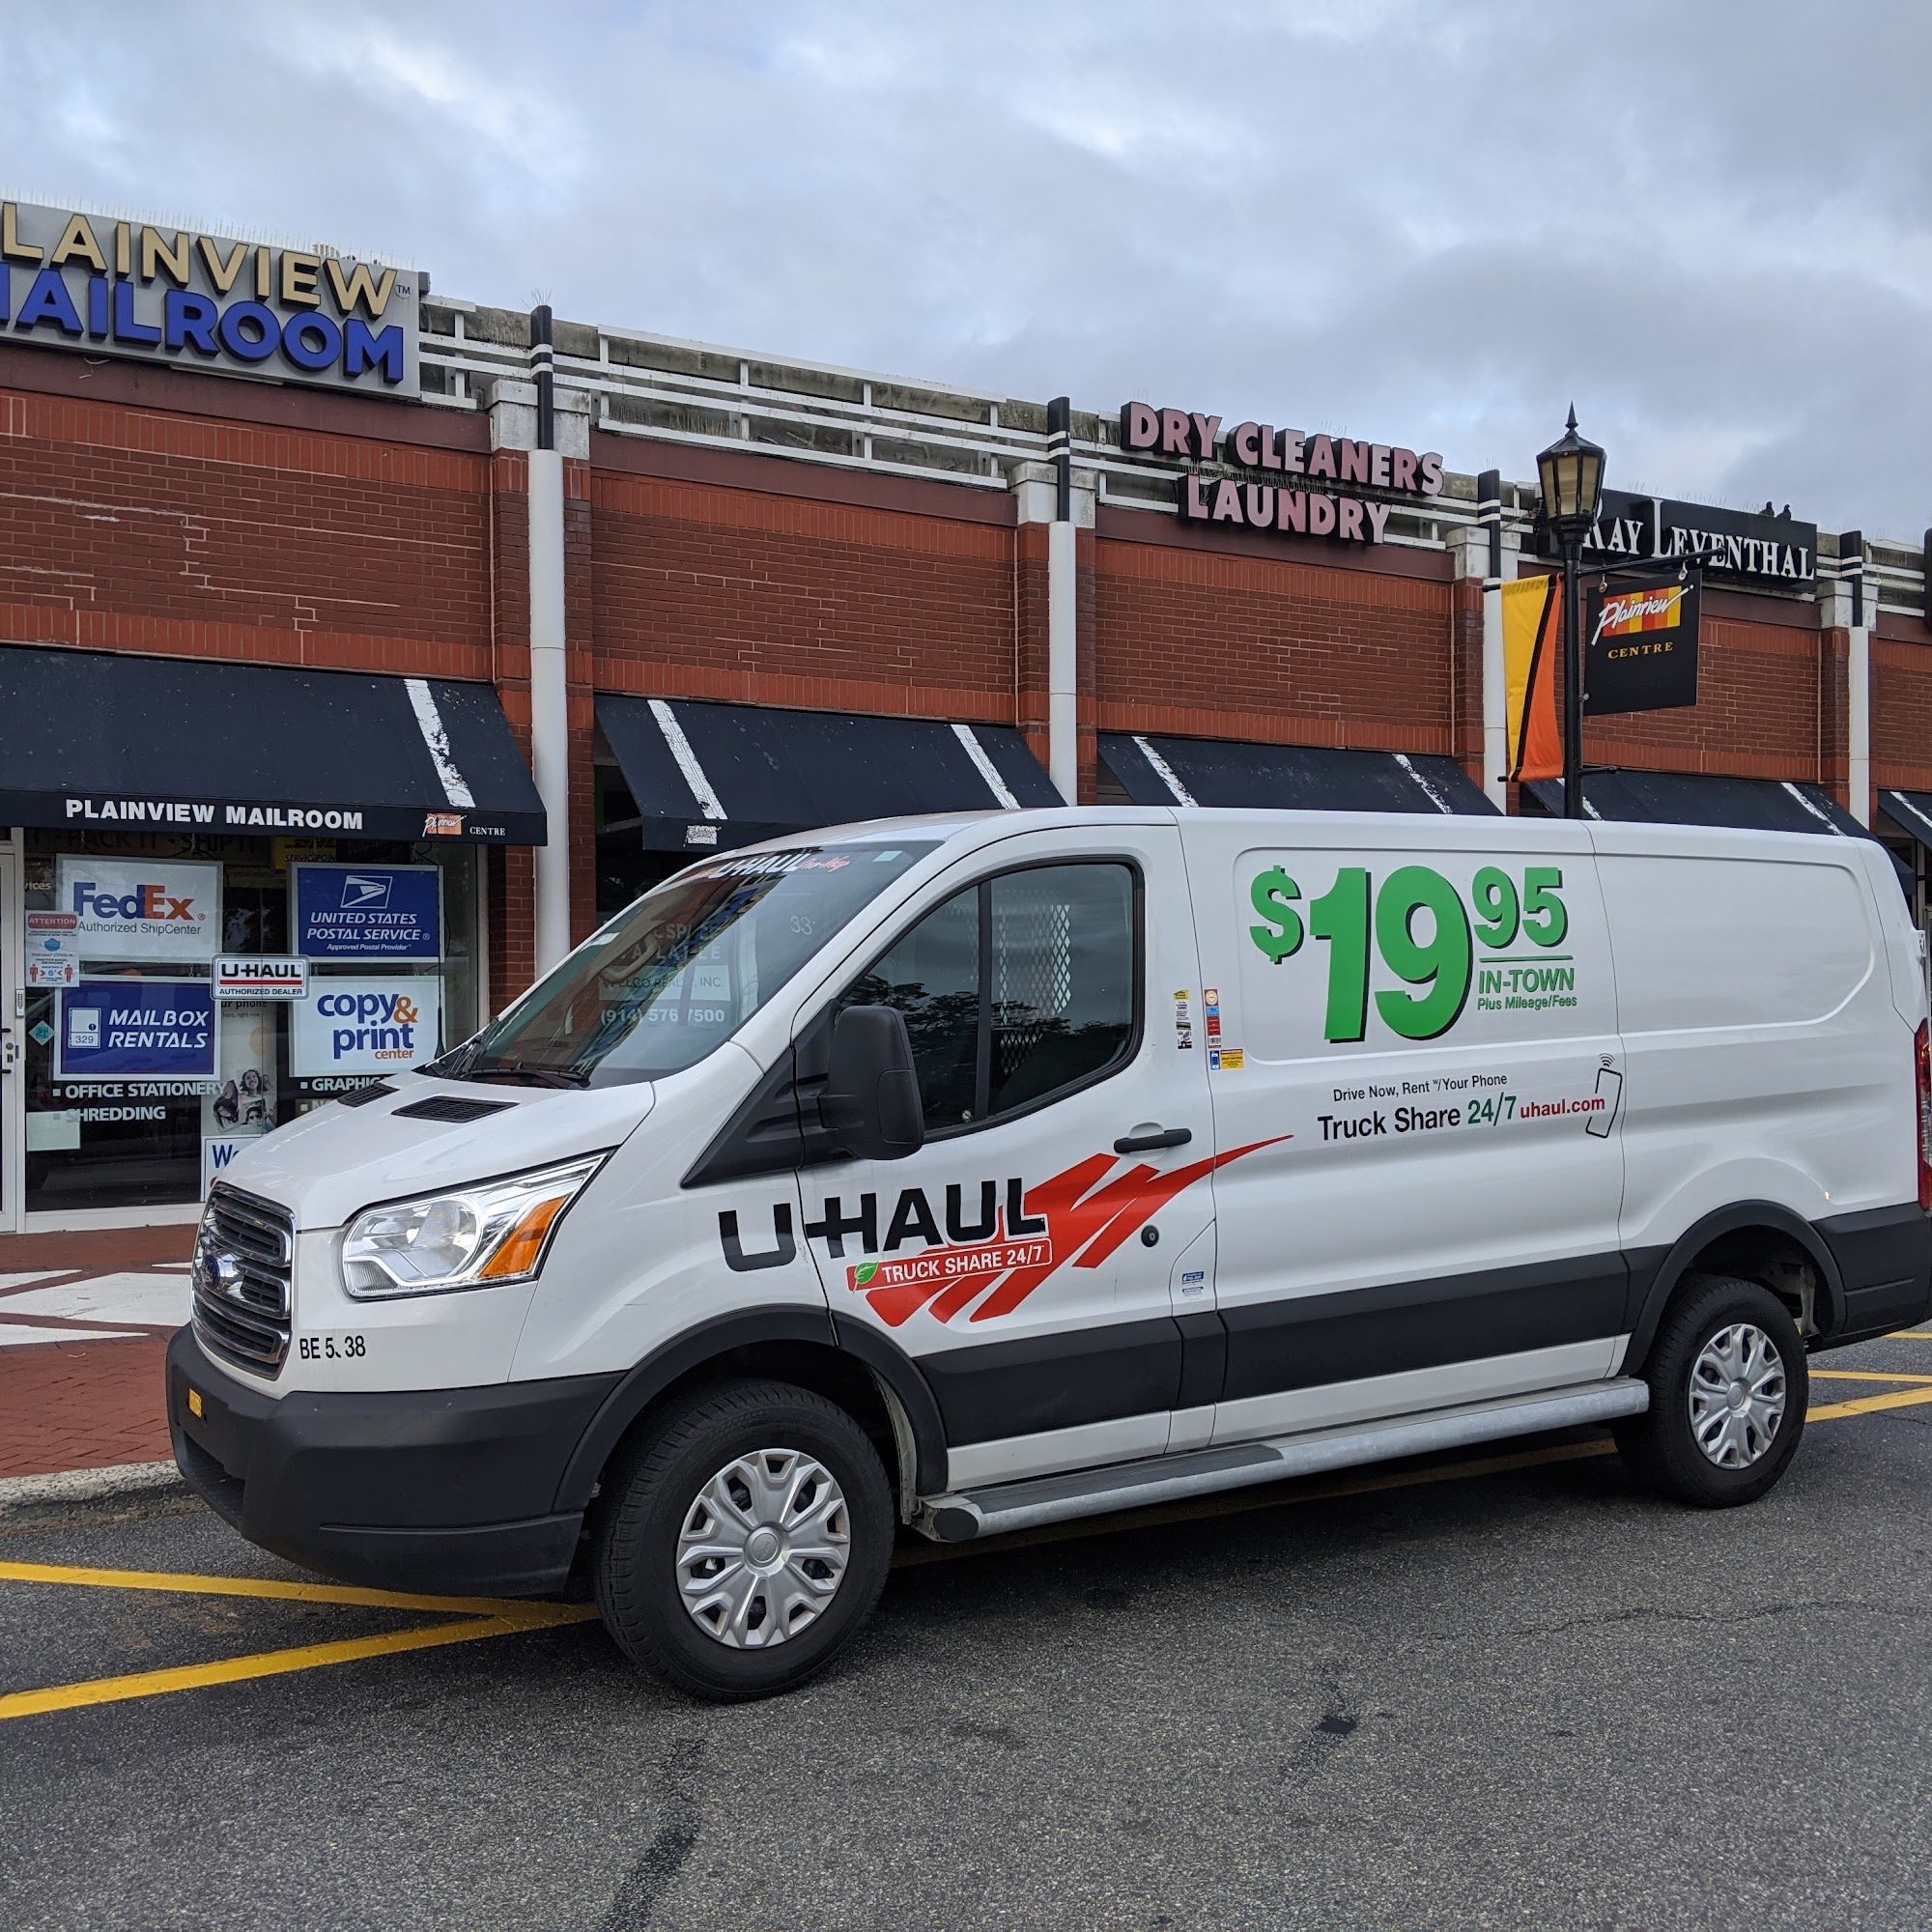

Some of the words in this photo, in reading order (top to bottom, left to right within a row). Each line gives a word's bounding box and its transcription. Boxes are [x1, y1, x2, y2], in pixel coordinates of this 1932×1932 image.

[2, 202, 397, 320] LAINVIEW
[1121, 401, 1223, 459] DRY
[1226, 421, 1445, 497] CLEANERS
[1178, 474, 1393, 545] LAUNDRY
[1651, 497, 1815, 581] LEVENTHAL
[1607, 641, 1674, 659] CENTRE
[66, 799, 214, 823] PLAINVIEW
[226, 806, 363, 830] MAILROOM
[469, 826, 506, 837] CENTRE
[73, 882, 195, 922] FedEx
[310, 912, 366, 923] UNITED
[367, 913, 417, 924] STATES
[78, 922, 137, 934] Authorized
[140, 923, 202, 936] ShipCenter
[307, 927, 361, 940] POSTAL
[363, 928, 421, 941] SERVICE
[221, 963, 301, 978] U-HAUL
[700, 977, 724, 988] INC.
[1478, 968, 1575, 994] IN-TOWN
[1477, 997, 1502, 1010] Plus
[108, 1009, 209, 1027] MAILBOX
[75, 1035, 94, 1044] 329
[108, 1032, 209, 1048] RENTALS
[333, 1020, 414, 1059] print
[374, 1049, 414, 1060] center
[65, 1083, 124, 1099] OFFICE
[128, 1081, 225, 1097] STATIONERY
[1333, 1086, 1365, 1102] Drive
[1368, 1083, 1400, 1098] Now,
[1402, 1080, 1431, 1095] Rent
[1471, 1074, 1508, 1088] Phone
[65, 1105, 166, 1122] SHREDDING
[1317, 1111, 1387, 1141] Truck
[1394, 1104, 1462, 1133] Share
[1467, 1092, 1518, 1126] 24/7
[1520, 1096, 1605, 1120] uhaul.com
[718, 1178, 1047, 1273] U-HAUL
[881, 1259, 942, 1284] TRUCK
[945, 1250, 1003, 1275] SHARE
[1007, 1244, 1043, 1266] 24/7
[299, 1337, 322, 1359] BE
